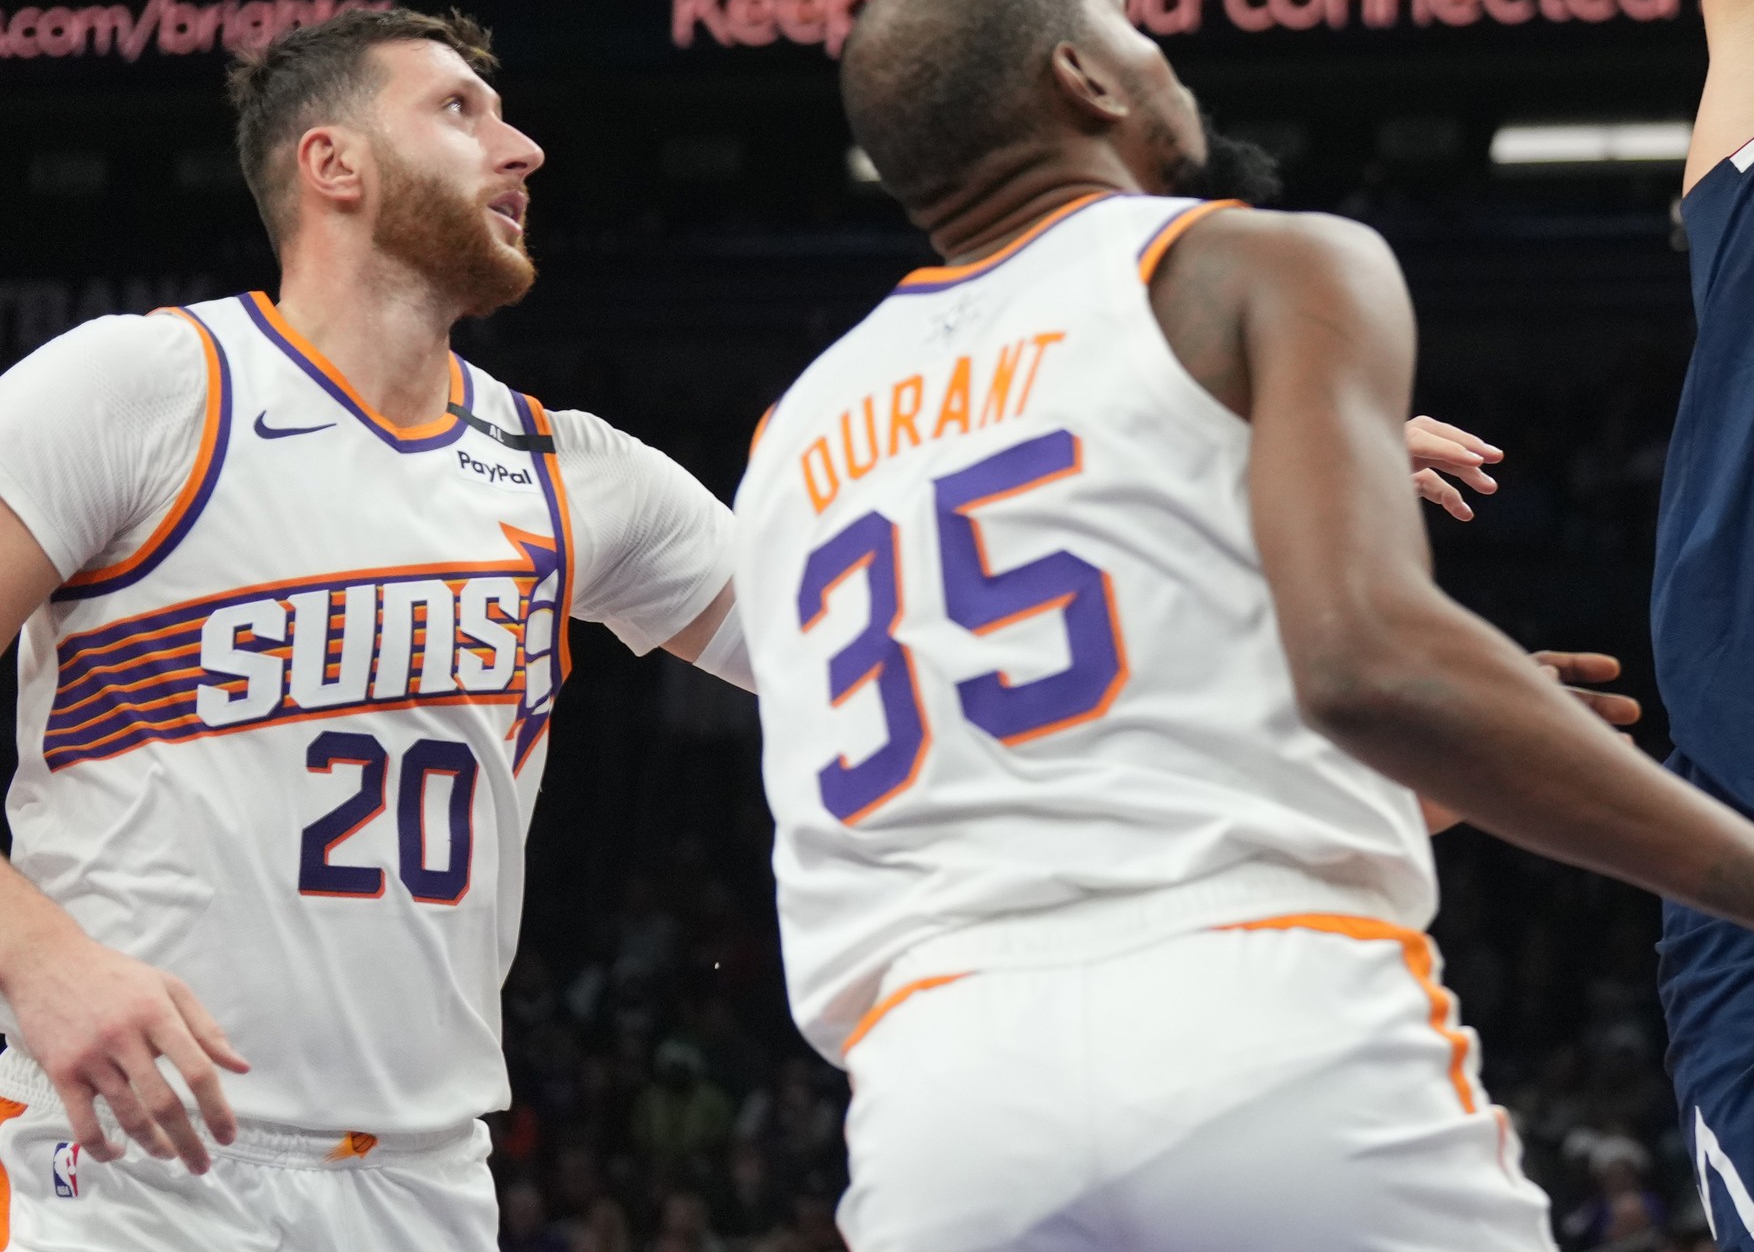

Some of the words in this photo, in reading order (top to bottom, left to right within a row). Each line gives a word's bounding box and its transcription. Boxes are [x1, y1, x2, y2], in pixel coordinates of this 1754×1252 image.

[457, 450, 533, 485] PayPal
[800, 330, 1068, 514] DURANT
[797, 428, 1130, 827] 35
[298, 731, 478, 906] 20
